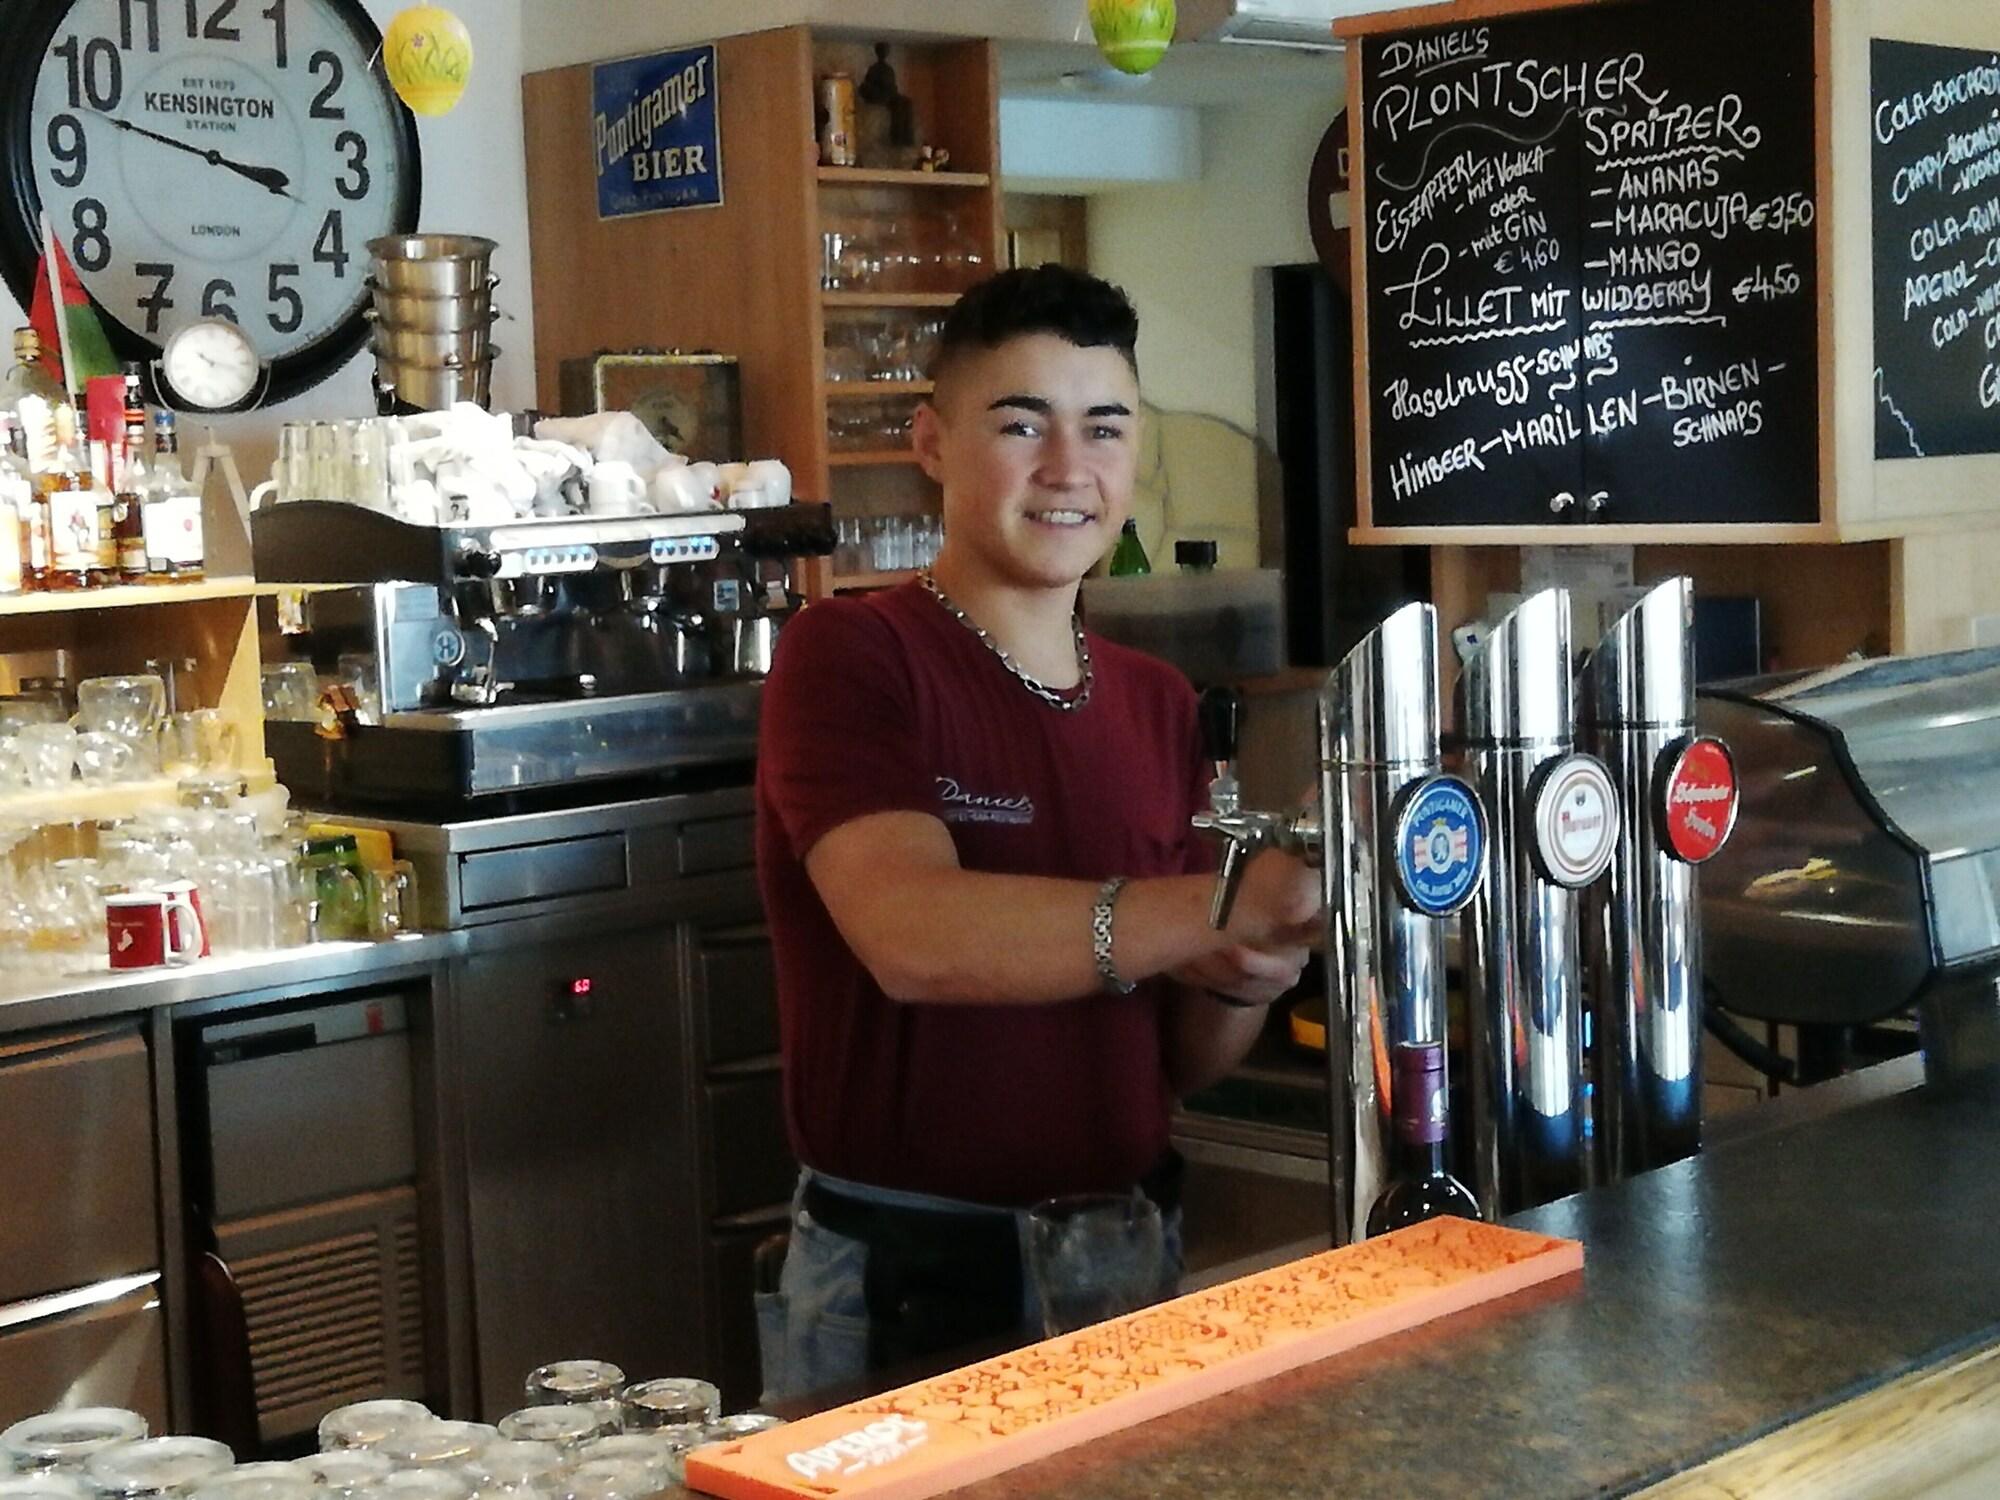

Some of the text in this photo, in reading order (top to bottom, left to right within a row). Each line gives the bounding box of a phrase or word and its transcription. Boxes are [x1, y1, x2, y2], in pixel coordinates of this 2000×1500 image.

[262, 0, 288, 69] 1
[1378, 27, 1490, 77] DANIEL'S
[53, 35, 123, 112] 10
[144, 91, 275, 119] KENSINGTON
[308, 50, 345, 120] 2
[1373, 52, 1669, 142] PLONTSCHER
[47, 114, 87, 188] 9
[185, 120, 236, 132] STATION
[593, 55, 708, 177] Puntigamer
[334, 130, 370, 200] 3
[632, 145, 707, 182] BIER
[72, 197, 112, 273] 8
[191, 224, 240, 237] LONDON
[312, 209, 349, 278] 4
[135, 262, 174, 333] 7
[201, 279, 238, 325] 6
[266, 264, 303, 334] 5
